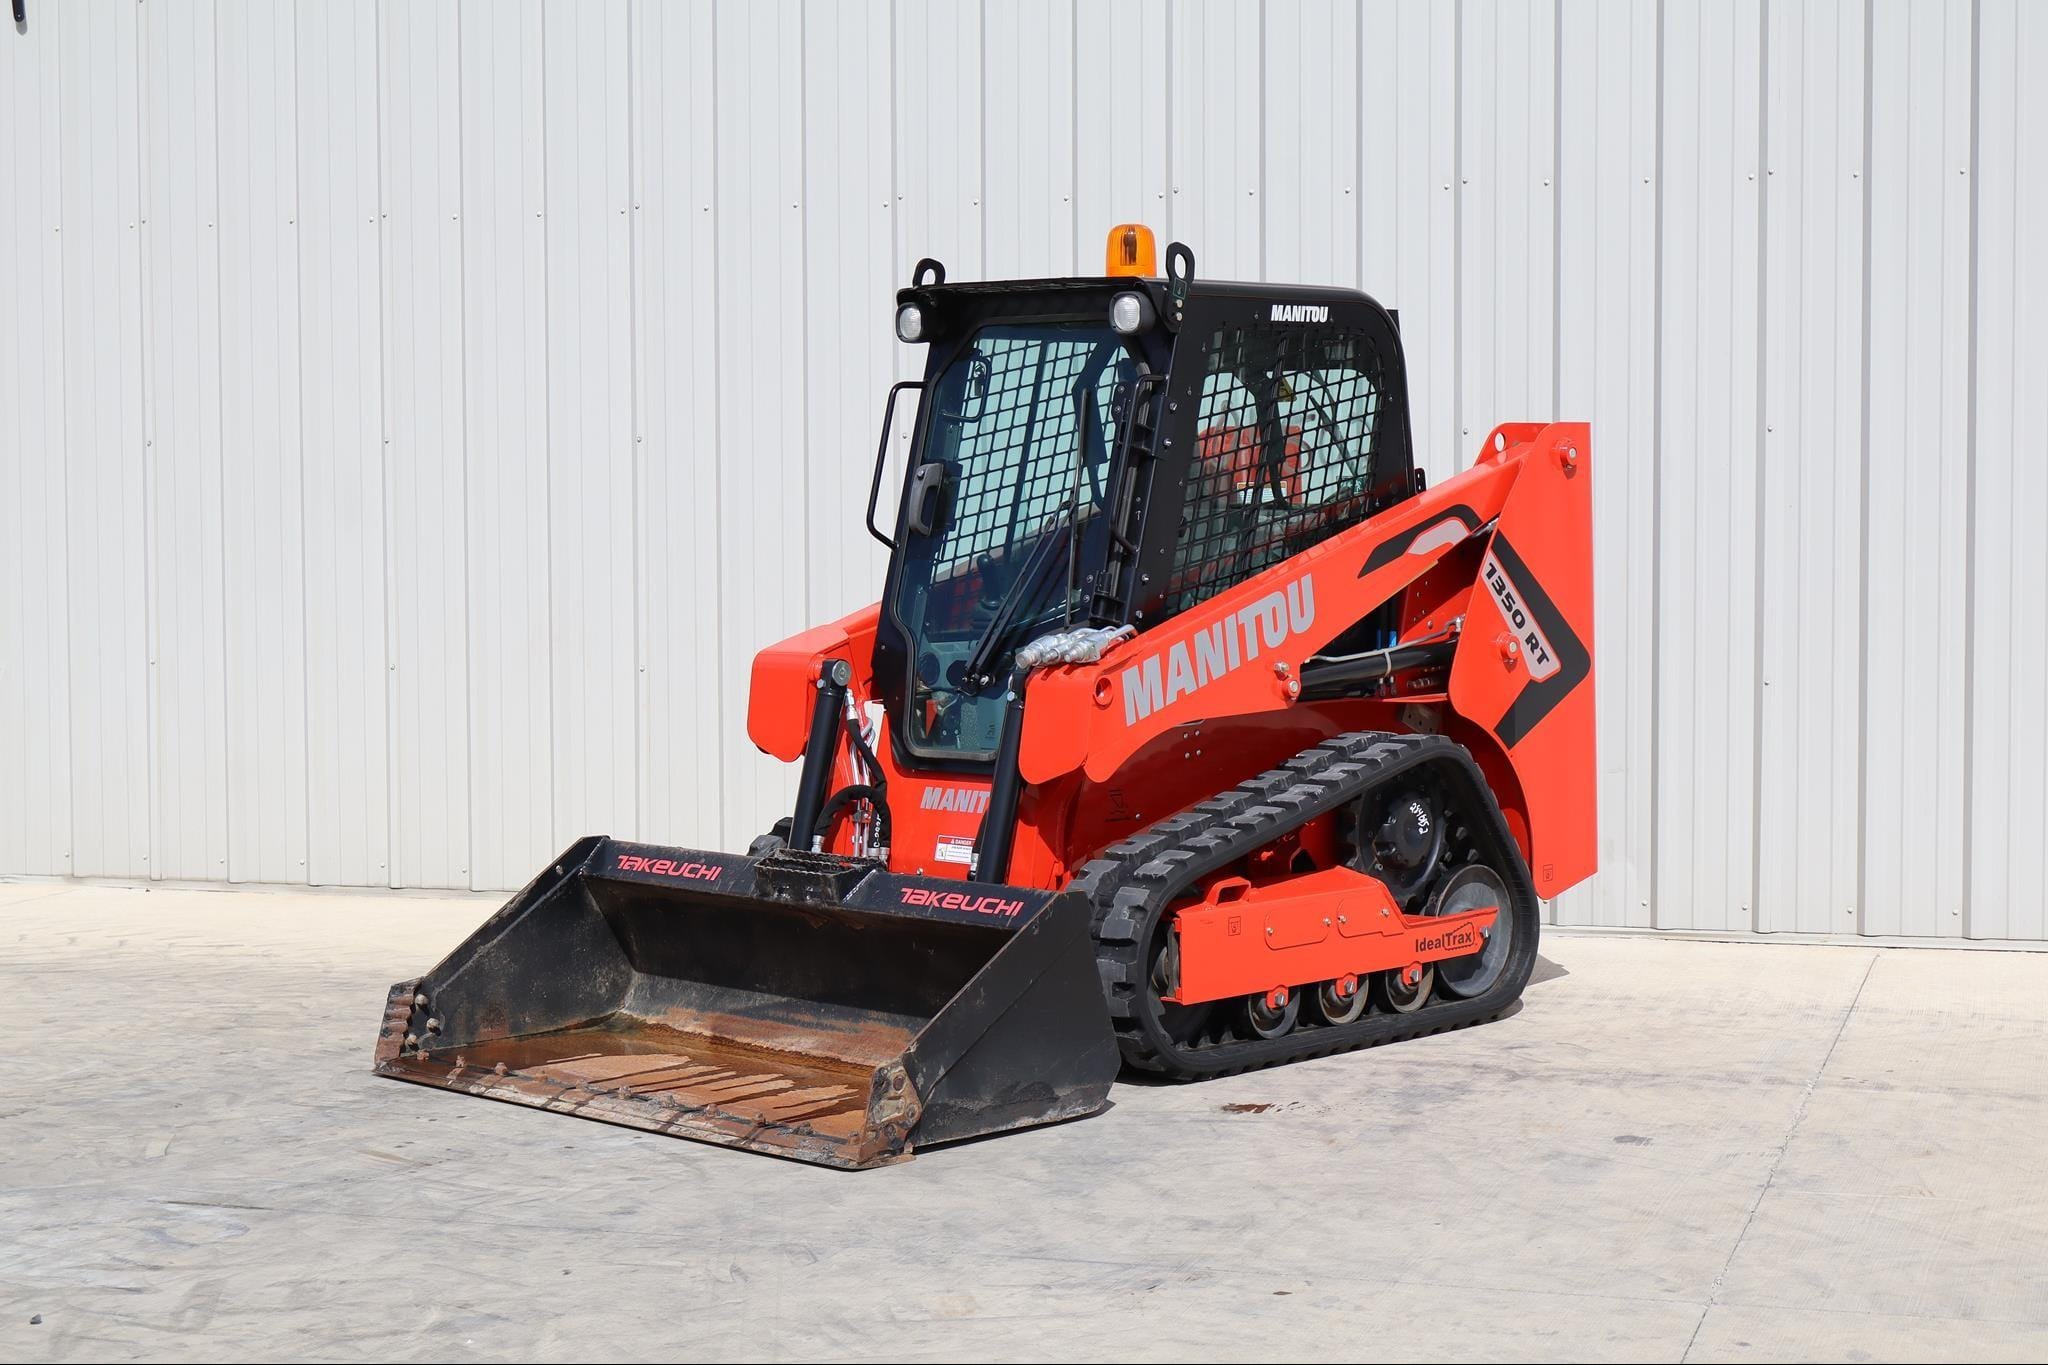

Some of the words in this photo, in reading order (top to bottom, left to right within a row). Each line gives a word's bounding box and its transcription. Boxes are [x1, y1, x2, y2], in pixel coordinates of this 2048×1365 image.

[1271, 304, 1329, 323] MANITOU
[1485, 562, 1527, 630] 1350
[1524, 631, 1550, 665] RT
[1121, 572, 1316, 728] MANITOU
[1415, 931, 1473, 953] IdealTrax
